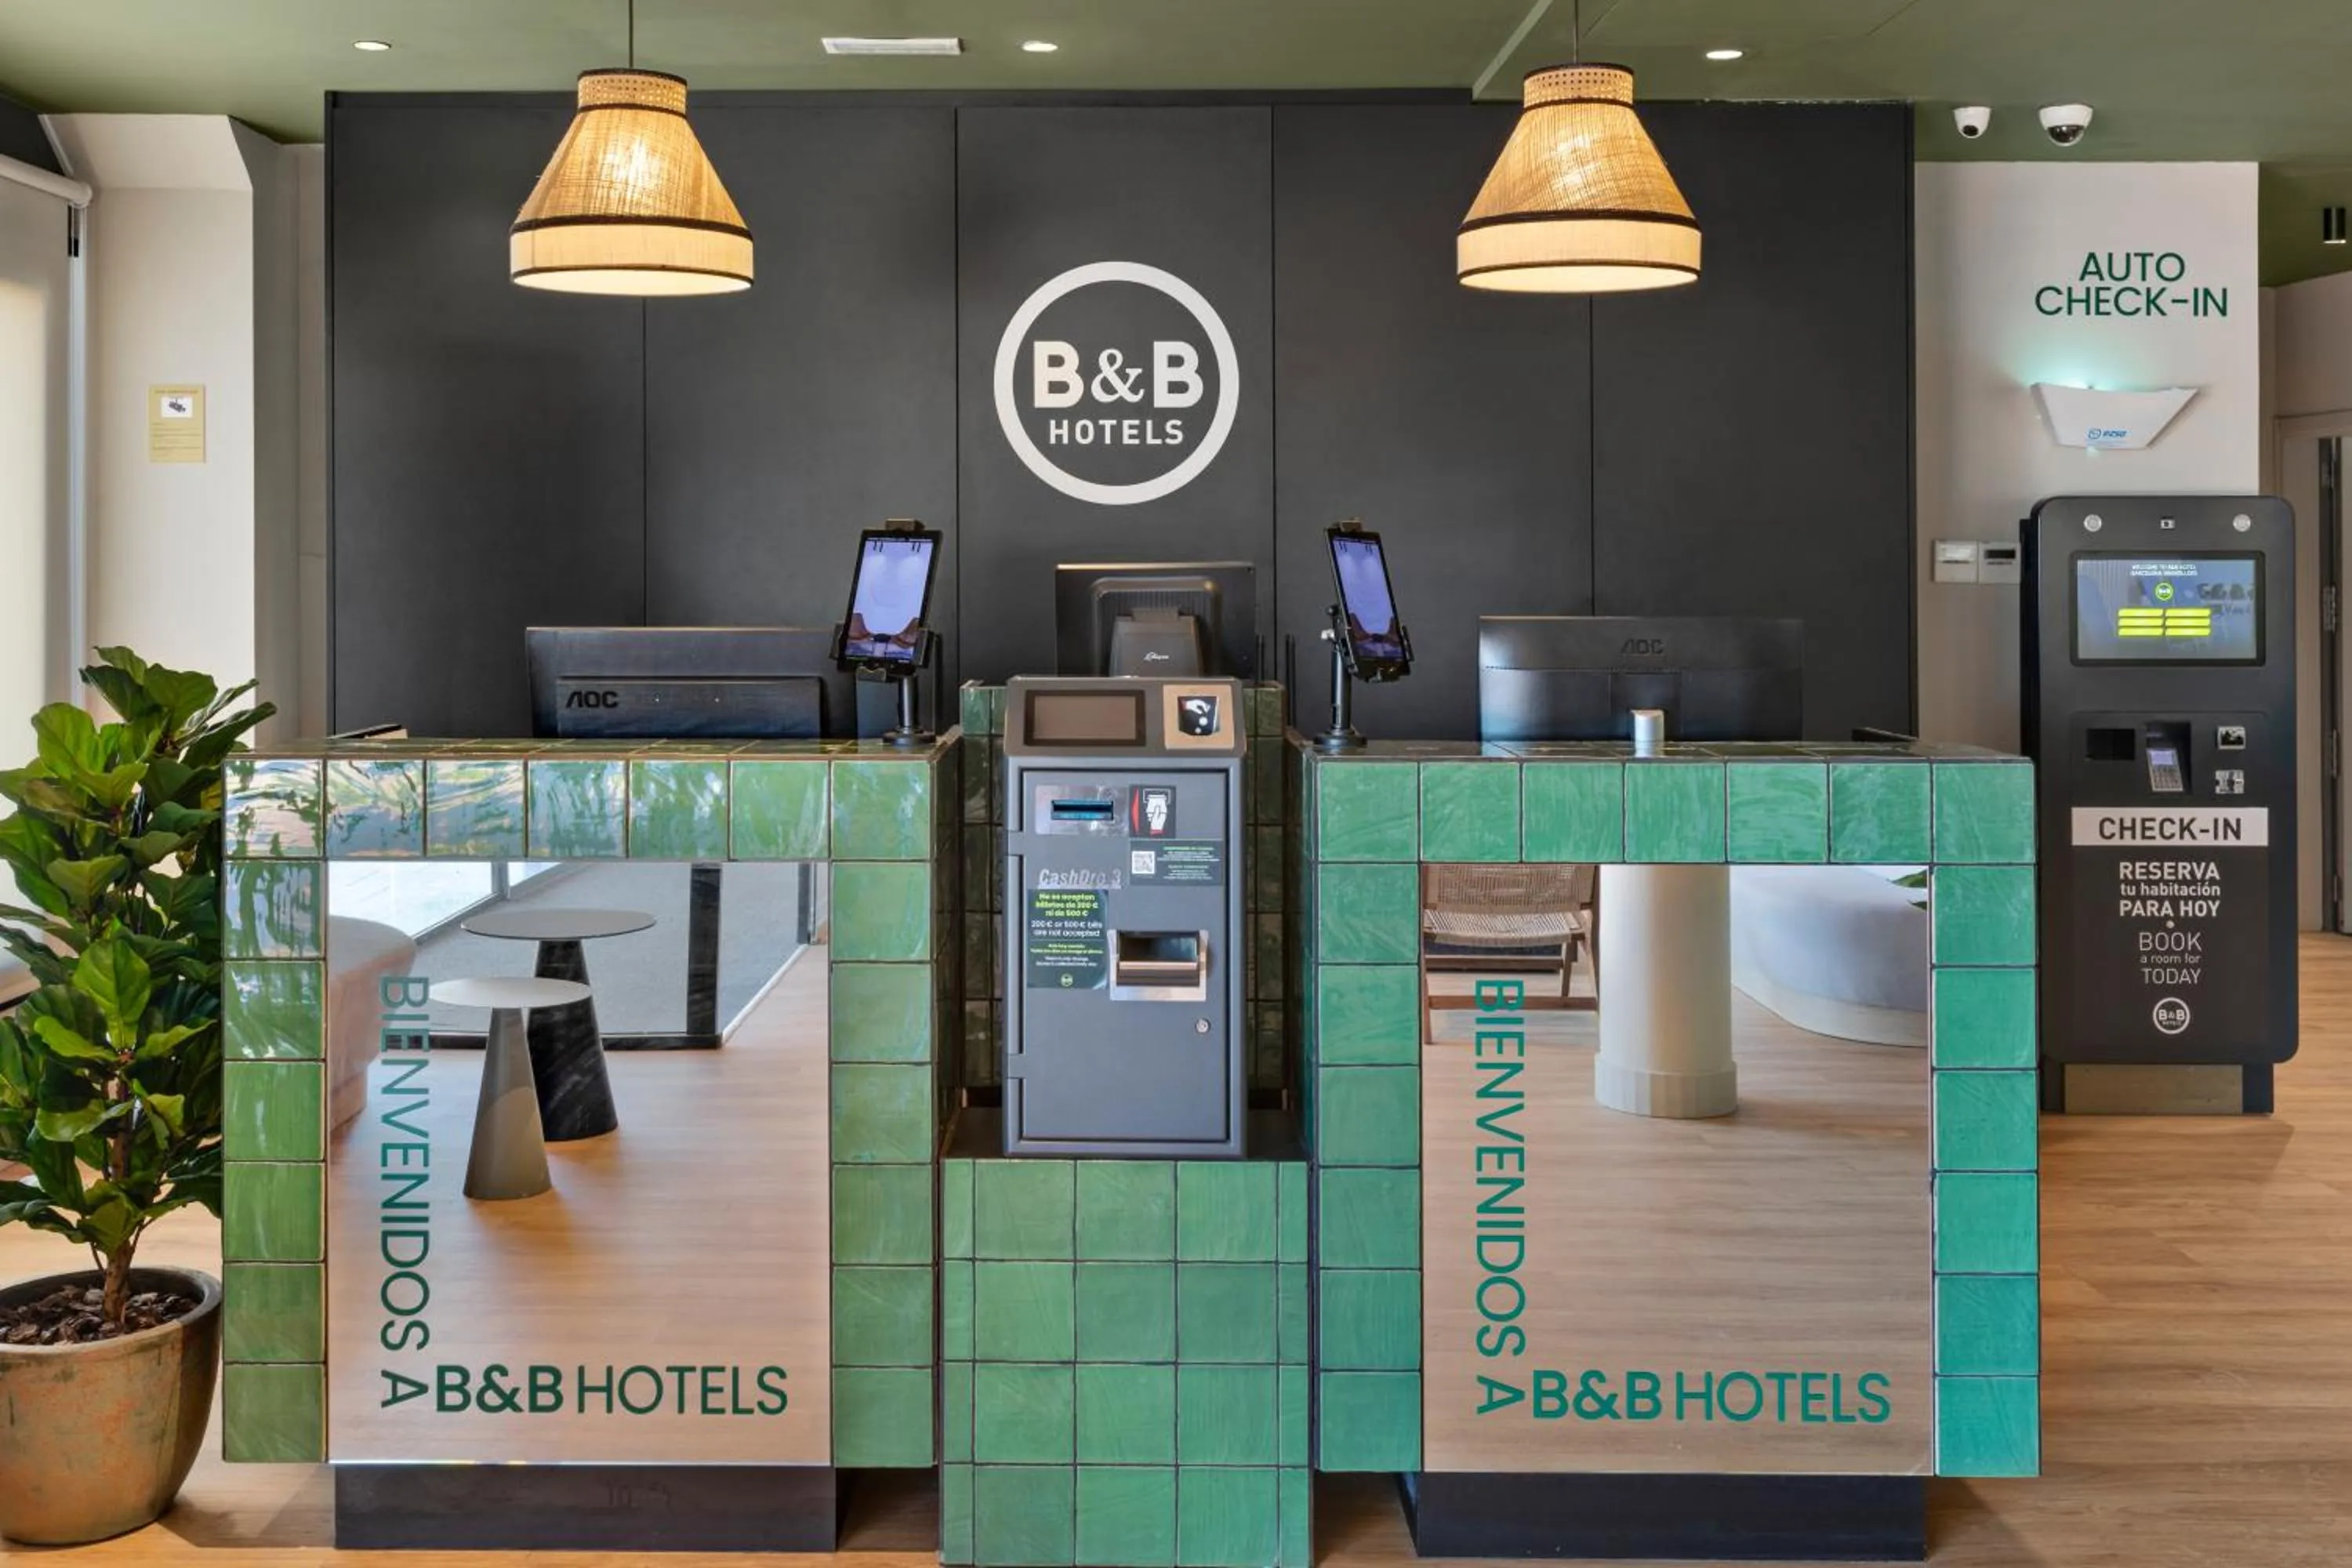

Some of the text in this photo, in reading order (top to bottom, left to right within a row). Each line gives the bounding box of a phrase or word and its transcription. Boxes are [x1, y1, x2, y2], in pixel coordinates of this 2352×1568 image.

[2079, 252, 2185, 282] AUTO
[2035, 286, 2227, 317] CHECK-IN
[1033, 340, 1203, 408] B&B
[1049, 419, 1184, 445] HOTELS
[1621, 638, 1664, 655] AOC
[566, 691, 619, 709] AOC
[2099, 817, 2242, 841] CHECK-IN
[2119, 862, 2221, 880] RESERVA
[2121, 881, 2221, 896] tu habitación
[2119, 899, 2220, 917] PARA HOY
[2139, 931, 2202, 951] BOOK
[2140, 953, 2201, 964] a room for
[2141, 968, 2201, 984] TODAY
[380, 976, 430, 1408] BIENVENIDOS A
[1475, 979, 1526, 1415] BIENVENIDOS A
[436, 1364, 788, 1415] B&B HOTELS
[1532, 1370, 1891, 1424] B&B HOTELS
